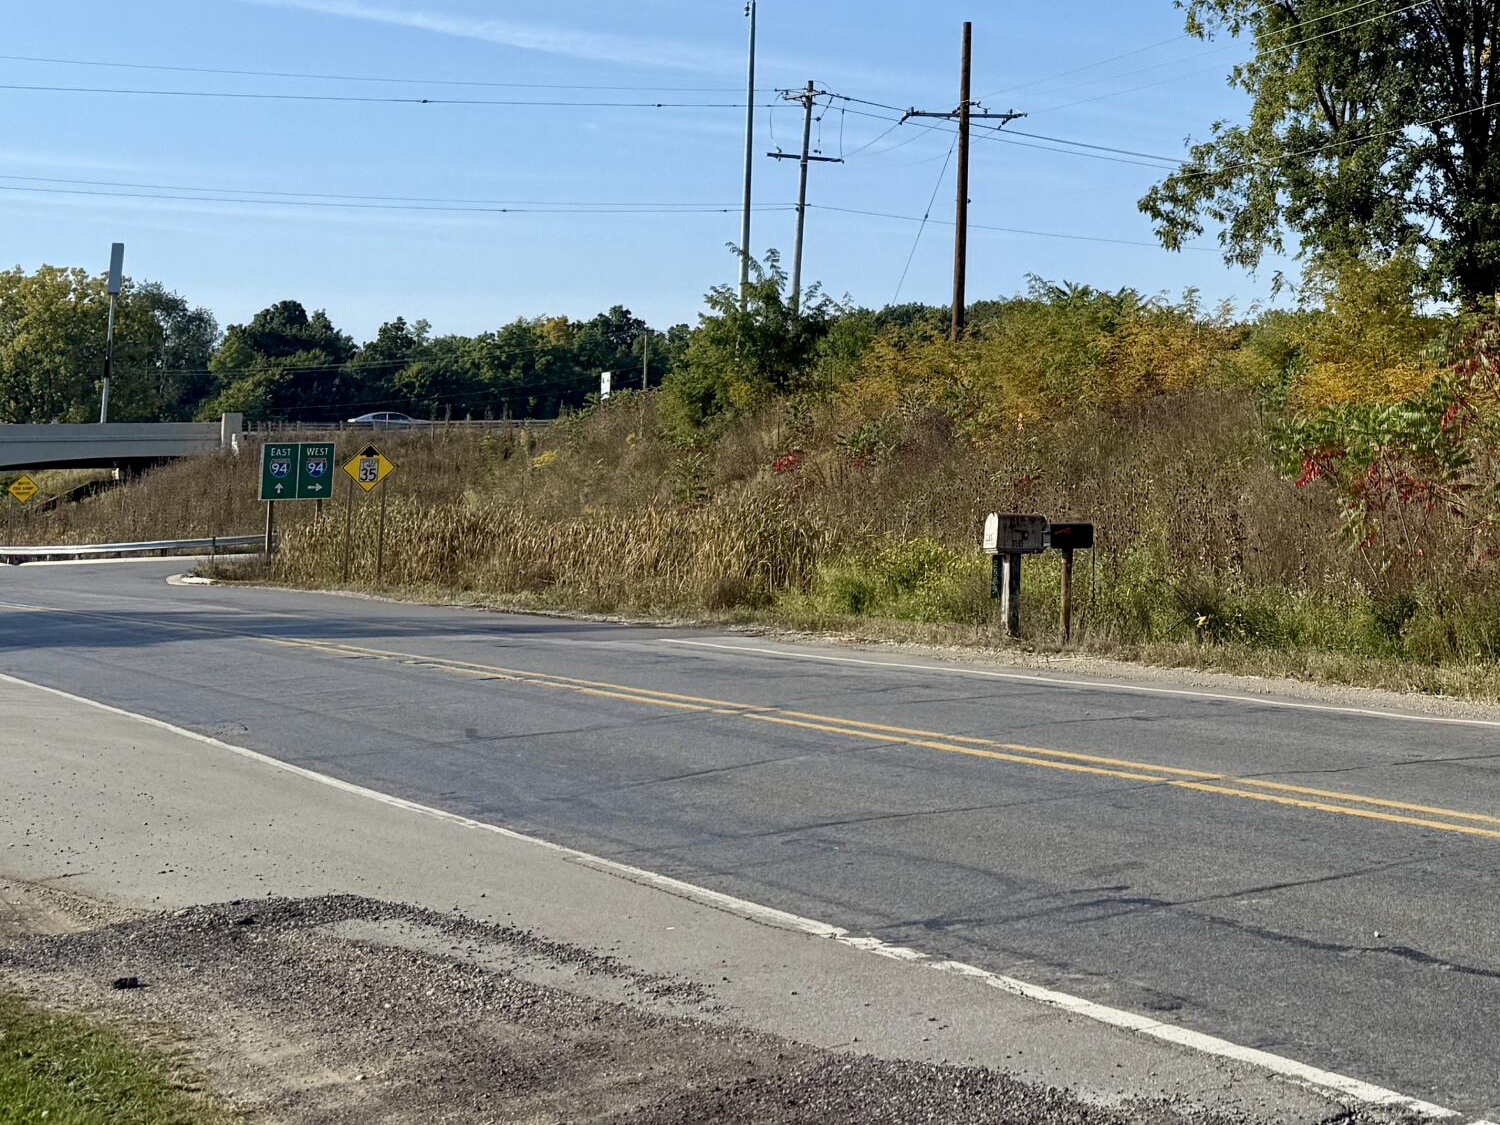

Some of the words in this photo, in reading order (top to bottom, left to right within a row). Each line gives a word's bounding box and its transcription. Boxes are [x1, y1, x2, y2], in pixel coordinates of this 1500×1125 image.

[271, 448, 291, 456] EAST
[306, 448, 328, 456] WEST
[271, 462, 287, 474] 94
[308, 462, 323, 473] 94
[360, 468, 376, 481] 35
